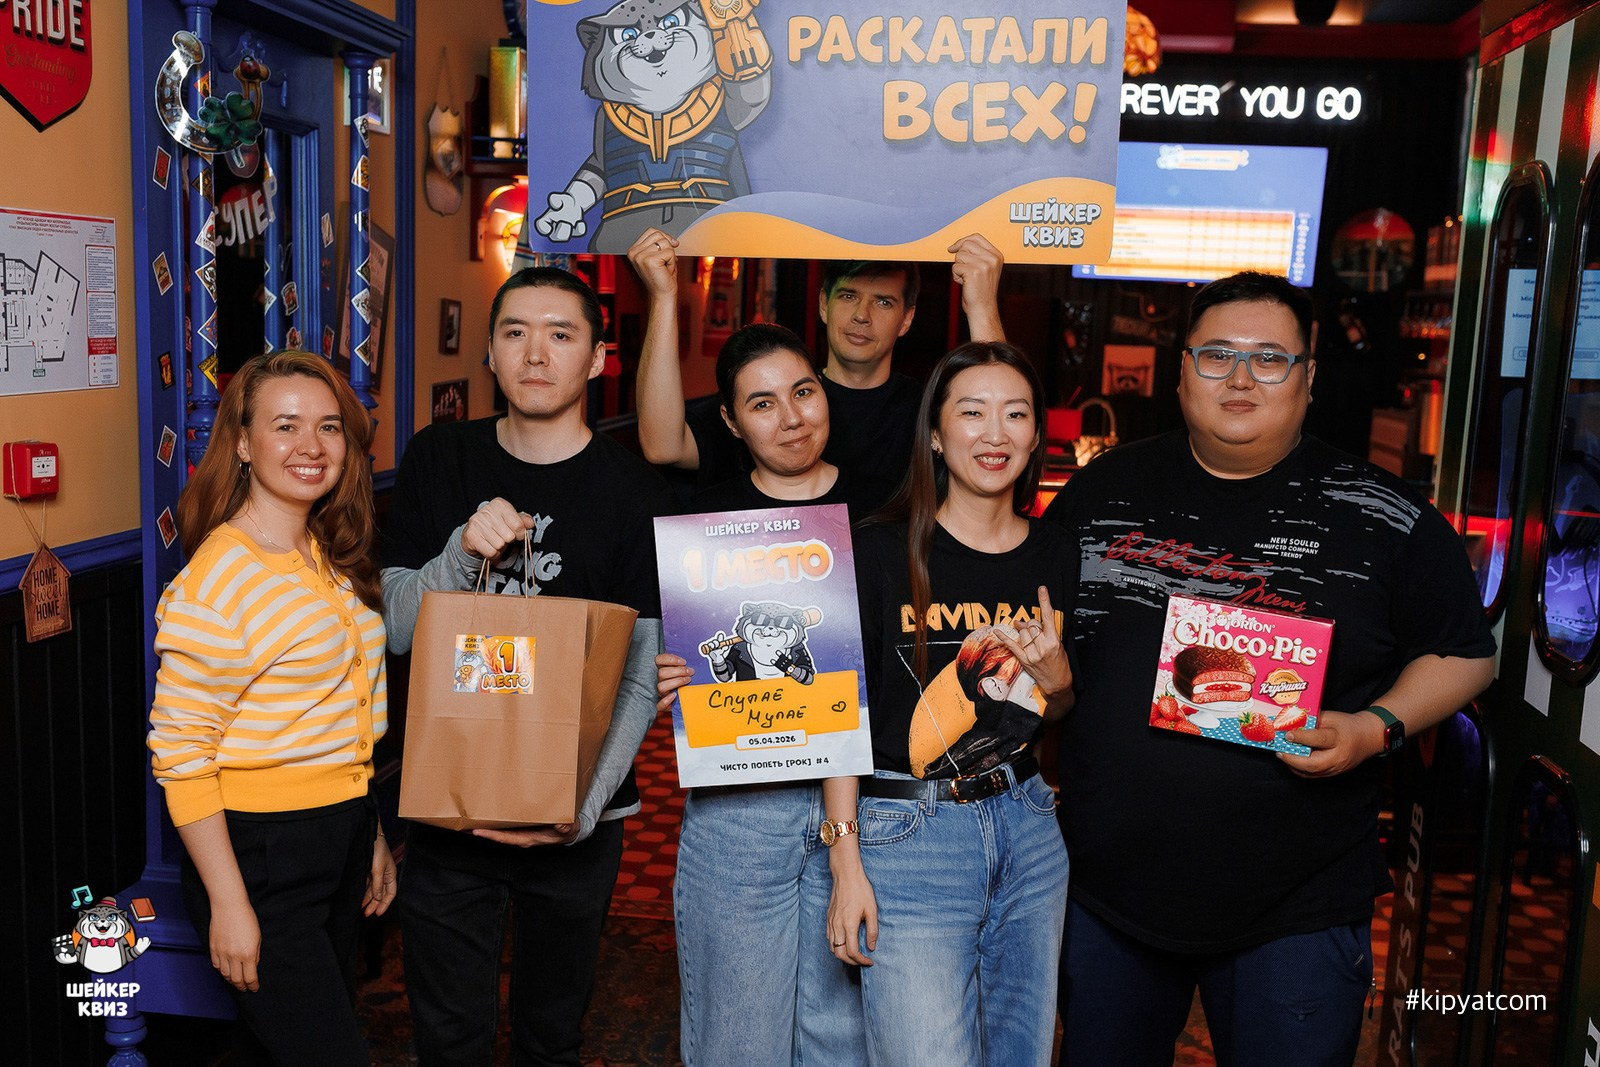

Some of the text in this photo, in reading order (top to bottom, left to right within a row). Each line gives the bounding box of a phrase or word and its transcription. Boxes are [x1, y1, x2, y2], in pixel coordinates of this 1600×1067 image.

[0, 0, 85, 47] RIDE
[787, 15, 1109, 65] РАСКАТАЛИ
[883, 80, 1099, 144] ВСЕХ!
[1240, 86, 1305, 119] YOU
[1316, 87, 1363, 120] GO
[1009, 197, 1101, 225] ШЕЙКЕР
[1023, 226, 1085, 248] КВИЗ
[705, 519, 801, 537] ШЕЙКЕР КВИЗ
[1288, 546, 1318, 554] COMPANY
[1289, 538, 1320, 548] SOULED
[682, 542, 831, 590] 1 МЕСТО
[33, 567, 58, 588] HOME
[1123, 577, 1157, 589] ARMSTRONG
[36, 600, 60, 621] HOME
[902, 602, 992, 632] DAVID
[499, 641, 515, 673] 1
[482, 673, 531, 688] МЕСТО
[748, 735, 796, 745] 05.04.2026
[720, 762, 749, 771] ЧИСТО
[751, 760, 783, 769] ПОПЕТЬ
[786, 758, 812, 768] [РОК]
[1404, 802, 1425, 910] PUB
